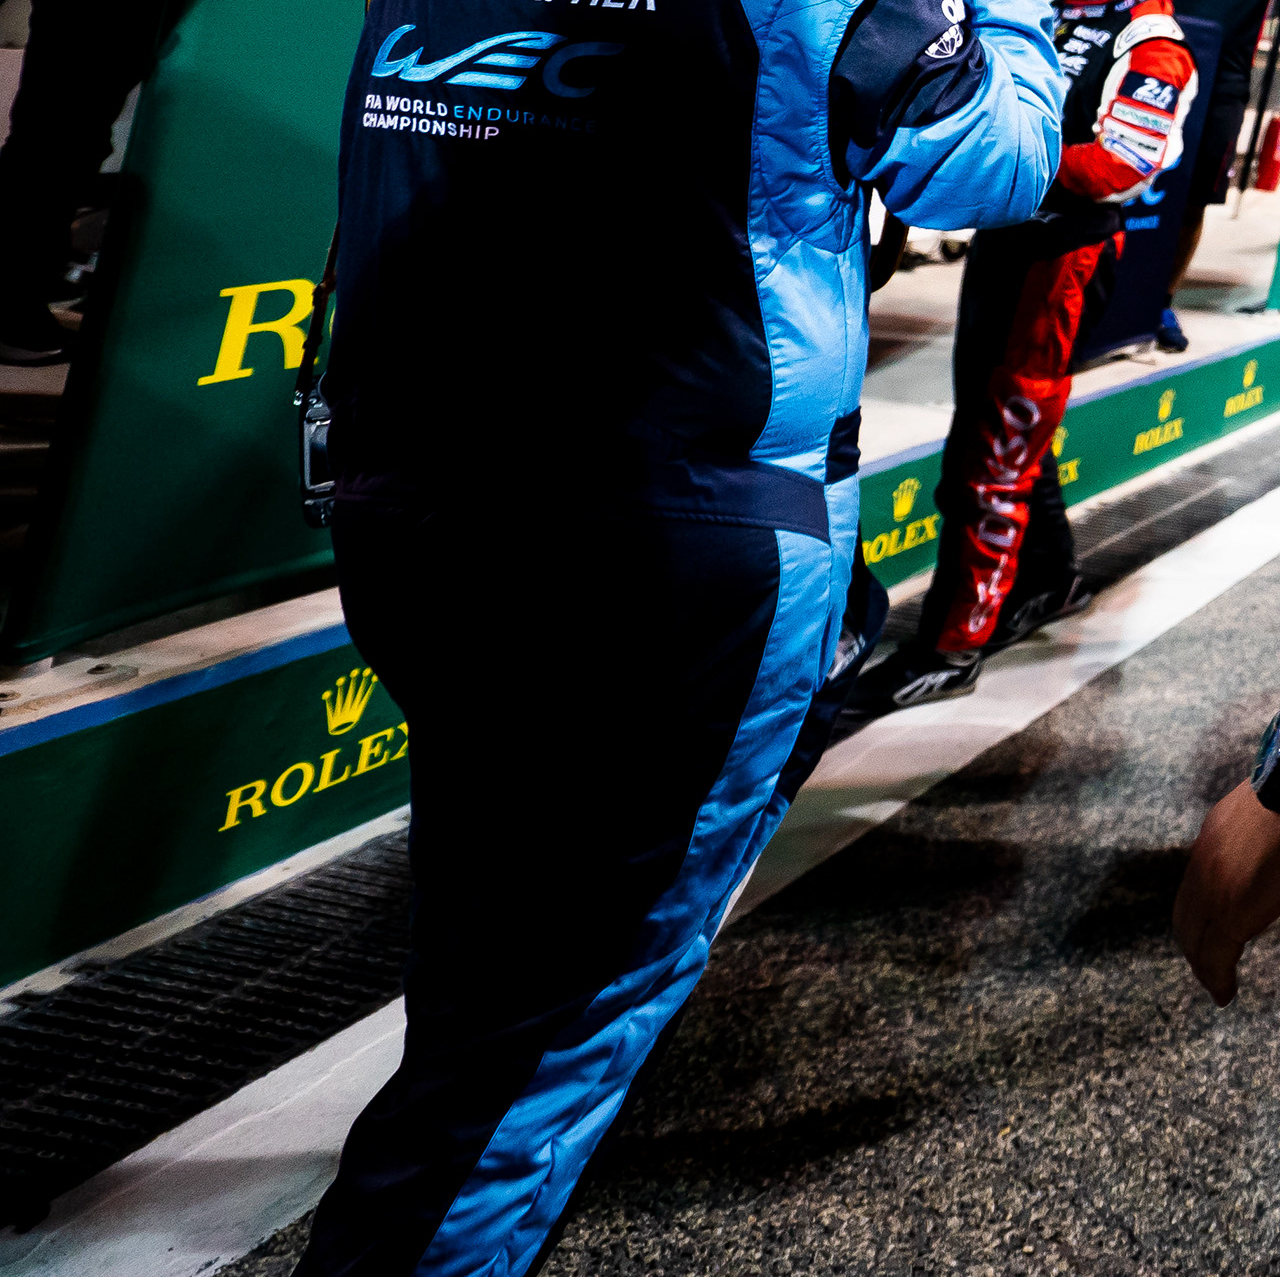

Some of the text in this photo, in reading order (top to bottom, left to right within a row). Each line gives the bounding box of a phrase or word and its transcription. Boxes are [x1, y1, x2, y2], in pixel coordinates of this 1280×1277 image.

[386, 97, 448, 117] WORLD
[362, 112, 500, 140] CHAMPIONSHIP
[1132, 417, 1185, 456] ROLEX
